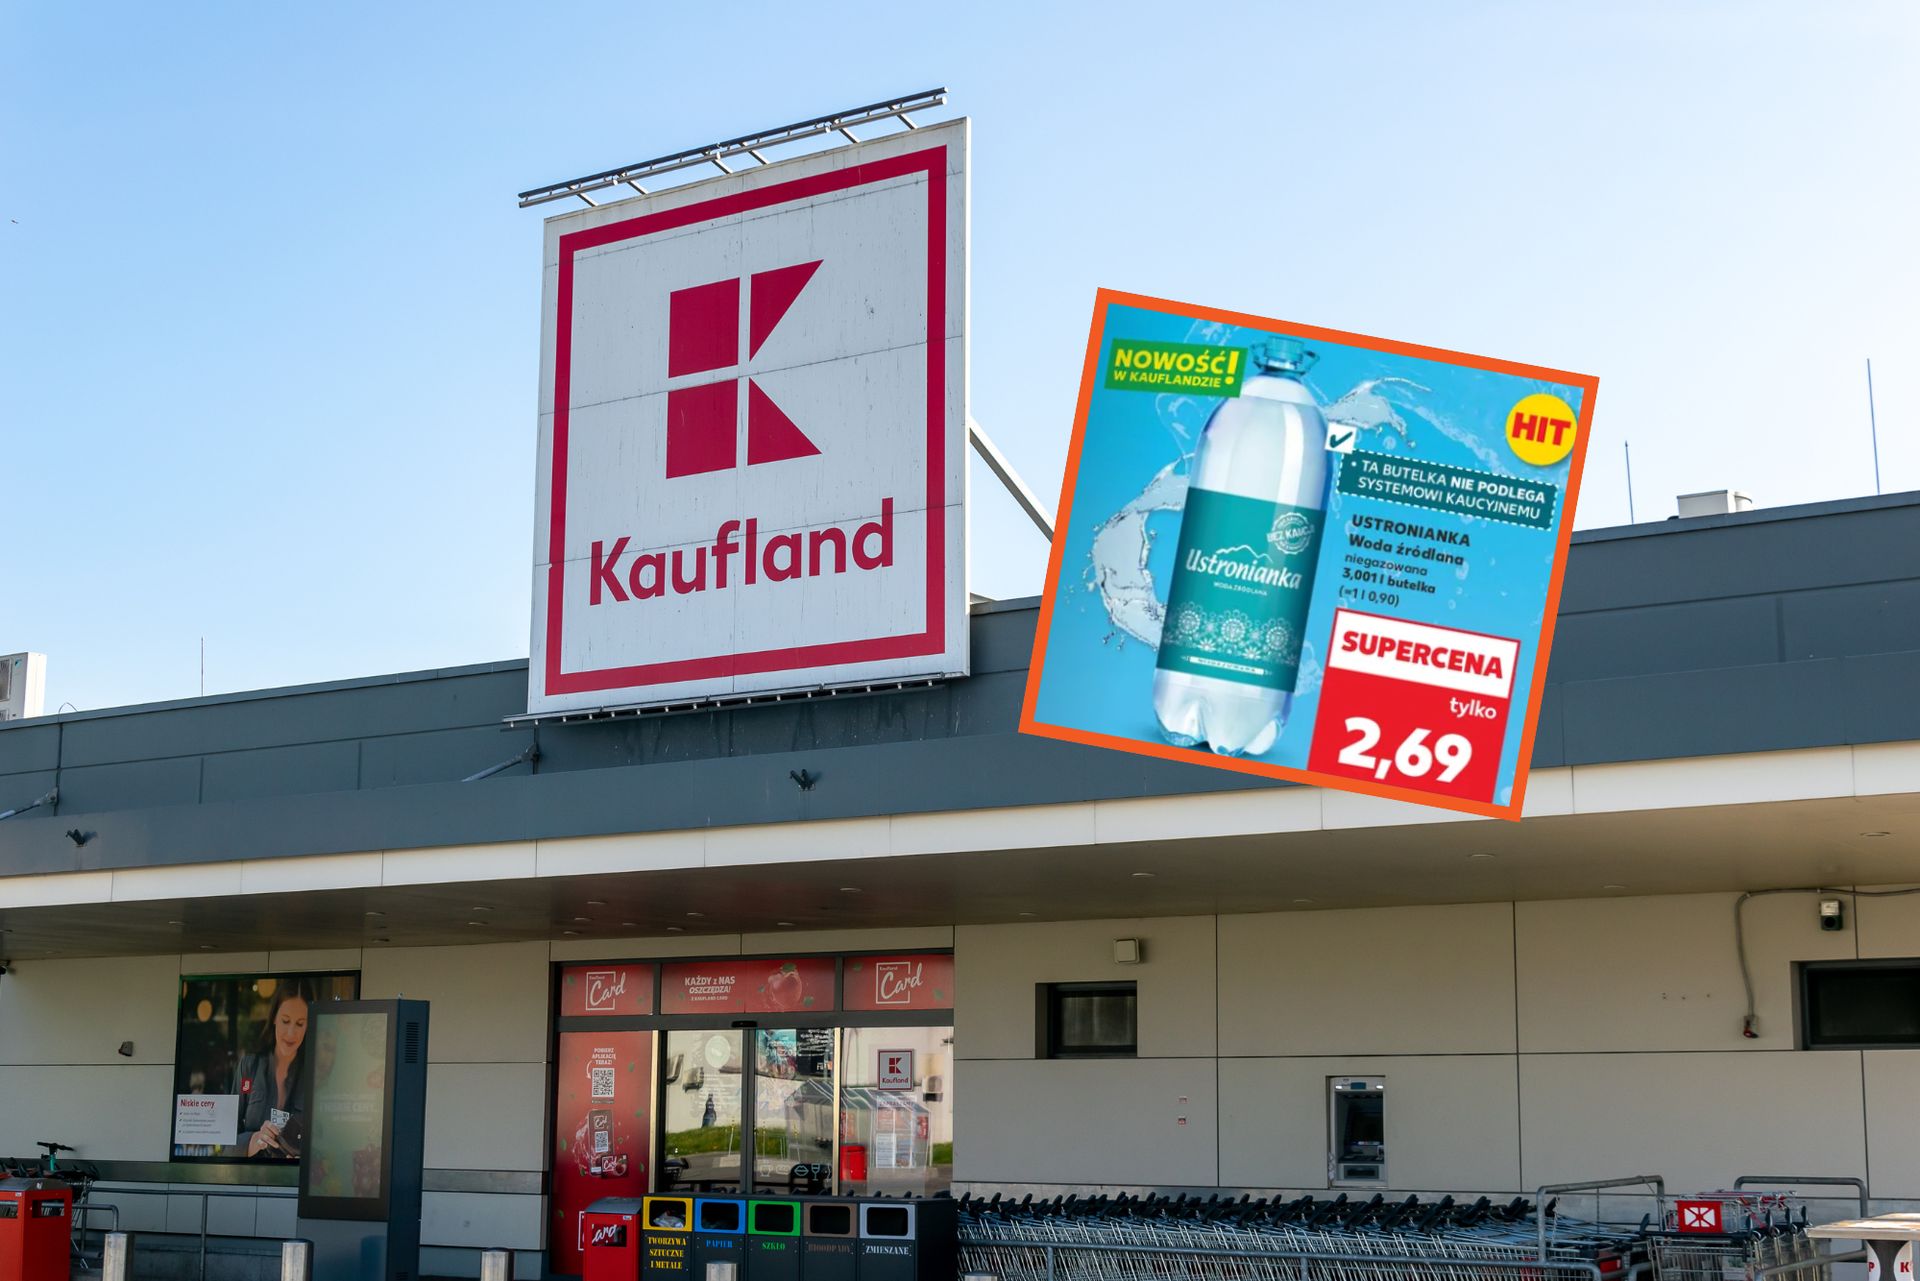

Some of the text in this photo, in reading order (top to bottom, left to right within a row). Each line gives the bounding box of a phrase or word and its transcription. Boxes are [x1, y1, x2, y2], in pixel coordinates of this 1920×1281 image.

[590, 497, 894, 606] Kaufland
[684, 975, 712, 986] KAŻDY
[718, 975, 736, 985] NAS
[880, 962, 924, 1000] Card
[590, 971, 627, 1007] Card
[180, 1098, 215, 1109] Niskie ceny
[648, 1236, 687, 1247] TWORZYWA
[705, 1239, 733, 1248] PAPIER
[649, 1249, 684, 1258] SZTUCZNE
[865, 1244, 910, 1255] ZMIESZANE
[650, 1260, 683, 1270] I METALE
